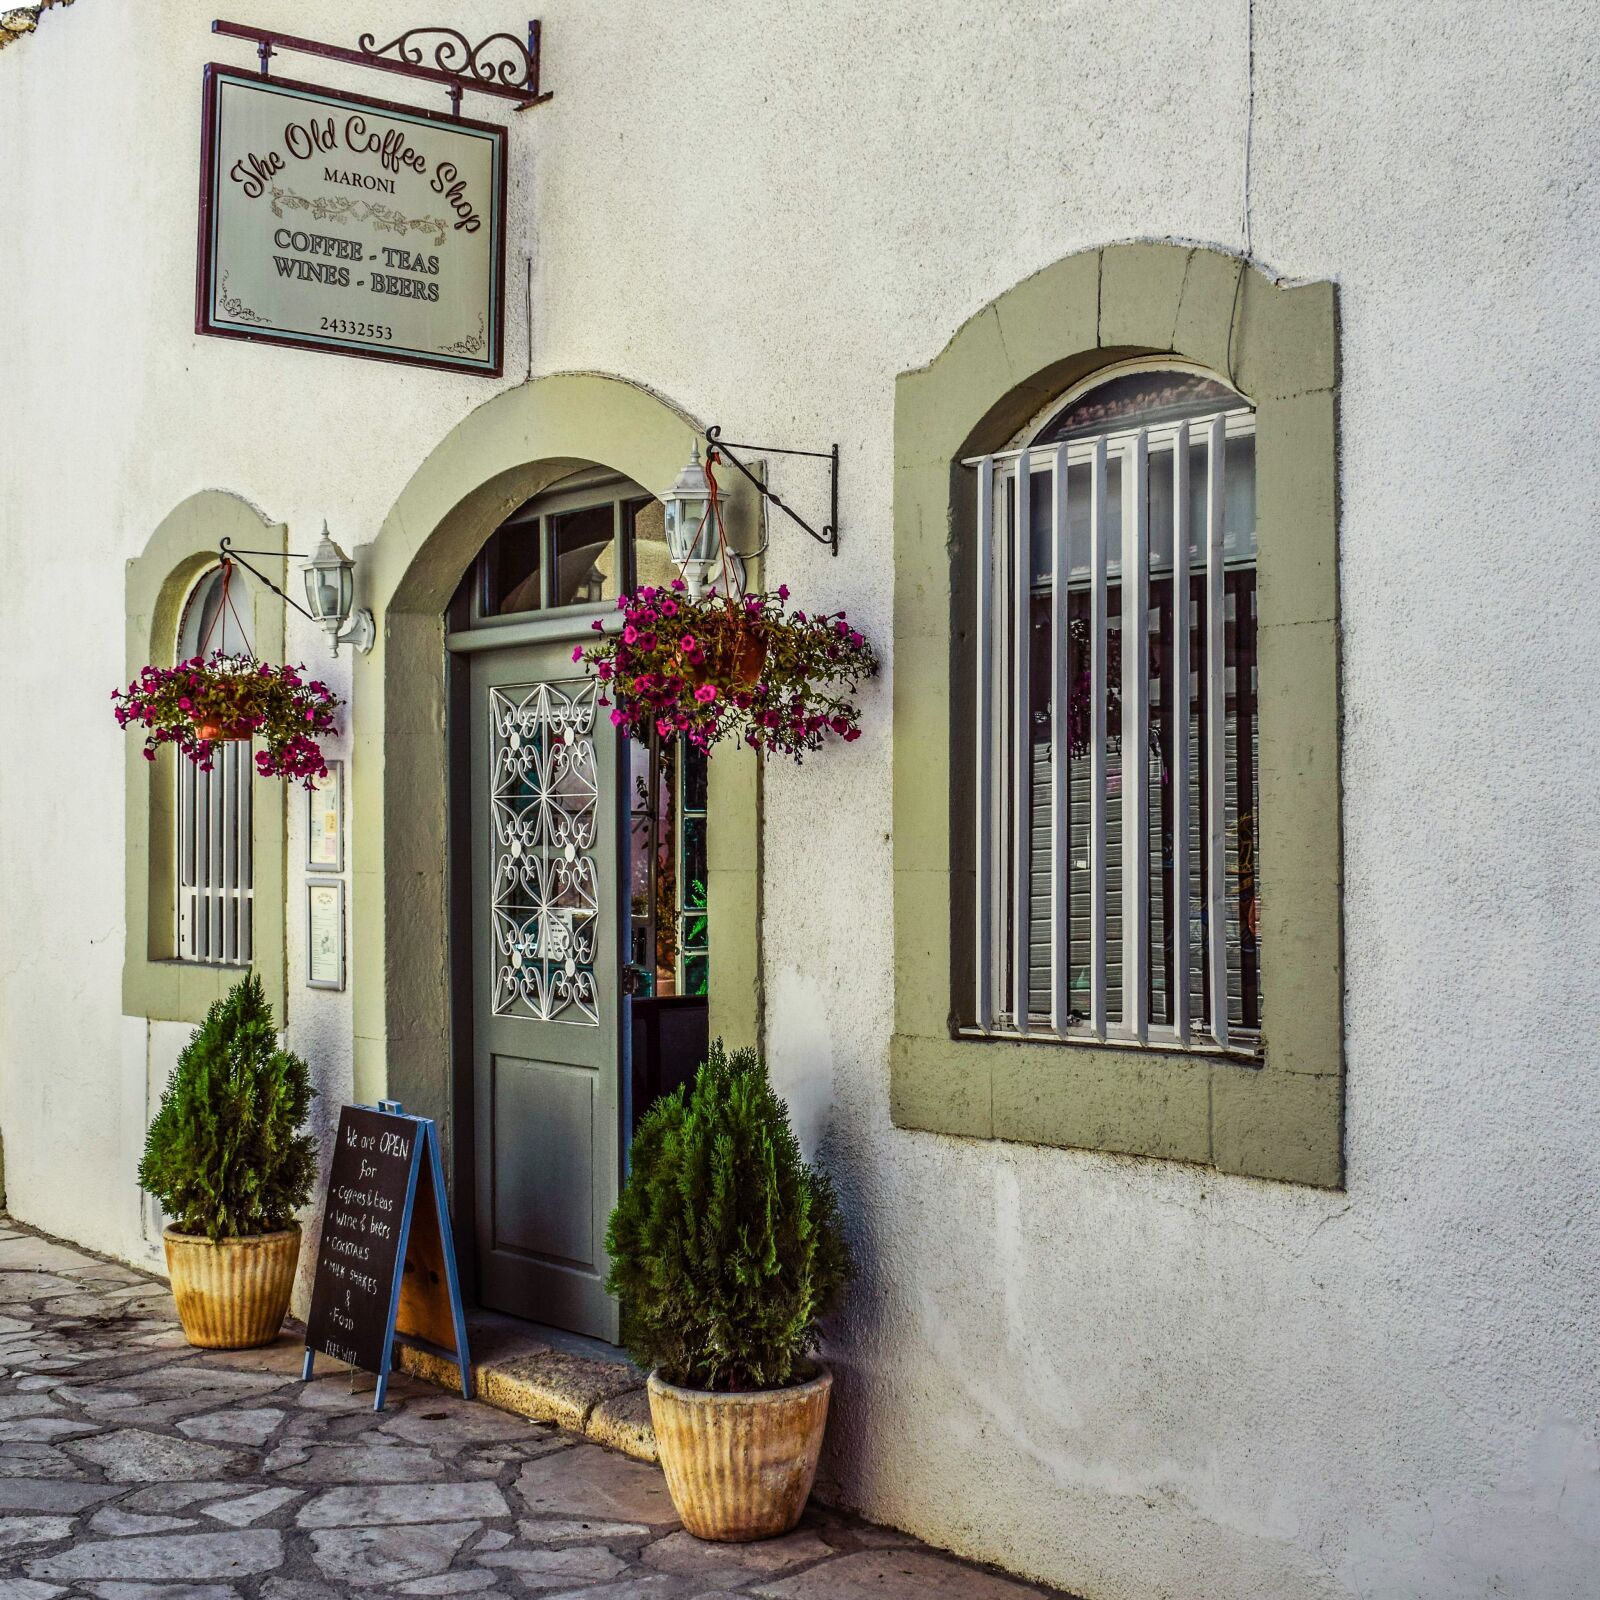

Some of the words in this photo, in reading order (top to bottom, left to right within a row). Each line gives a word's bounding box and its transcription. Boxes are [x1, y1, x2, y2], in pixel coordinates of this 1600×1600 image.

[230, 151, 285, 198] The
[284, 117, 338, 160] Old
[344, 115, 427, 175] Coffee
[430, 161, 481, 234] Shop
[323, 167, 396, 194] MARONI
[274, 228, 363, 262] COFFEE
[382, 247, 440, 275] TEAS
[272, 255, 350, 287] WINES
[370, 272, 440, 302] BEERS
[320, 317, 393, 340] 24332553
[346, 1125, 358, 1148] We
[361, 1136, 376, 1151] are
[379, 1131, 409, 1160] OPEN
[358, 1158, 377, 1180] for
